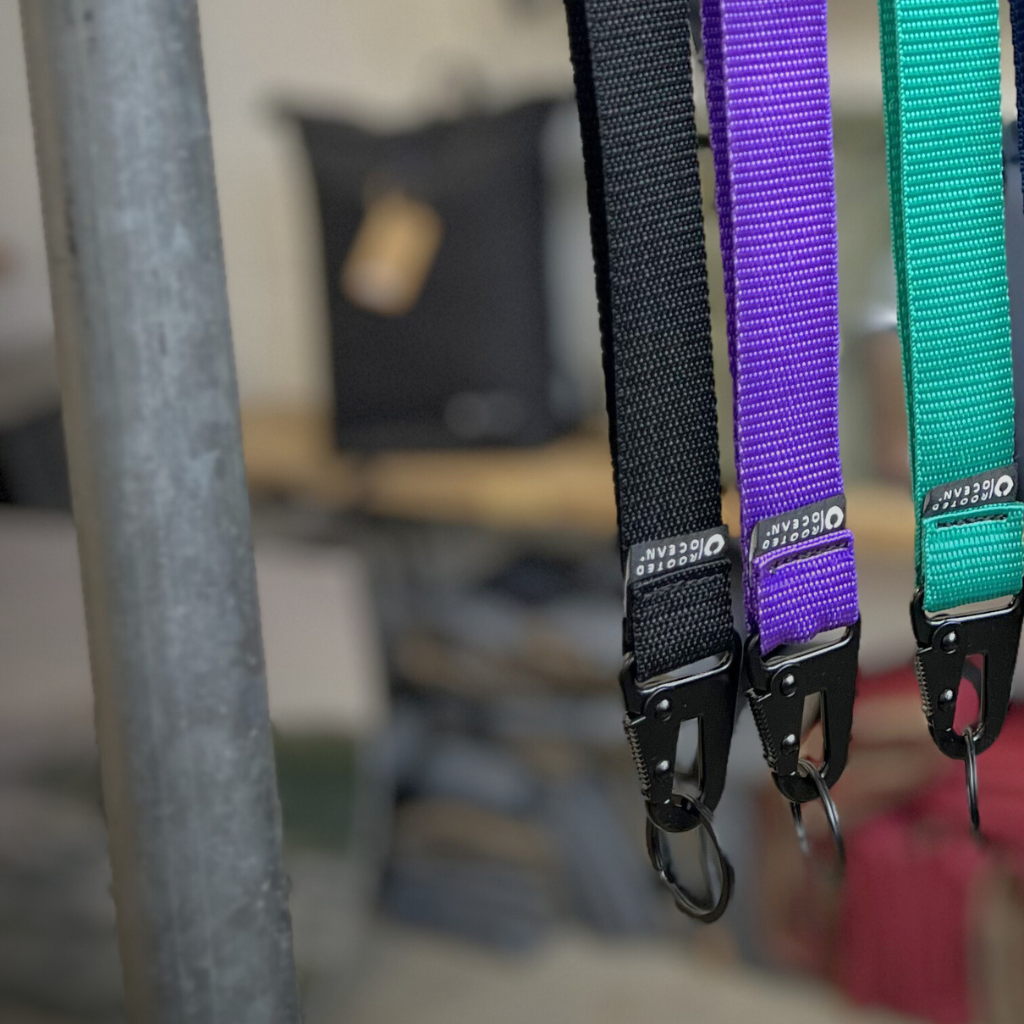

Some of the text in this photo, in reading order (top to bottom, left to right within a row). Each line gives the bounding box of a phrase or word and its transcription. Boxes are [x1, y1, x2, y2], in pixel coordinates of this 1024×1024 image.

[932, 492, 988, 511] ROOTED
[762, 525, 819, 550] ROOTED
[636, 552, 698, 576] ROOTED
